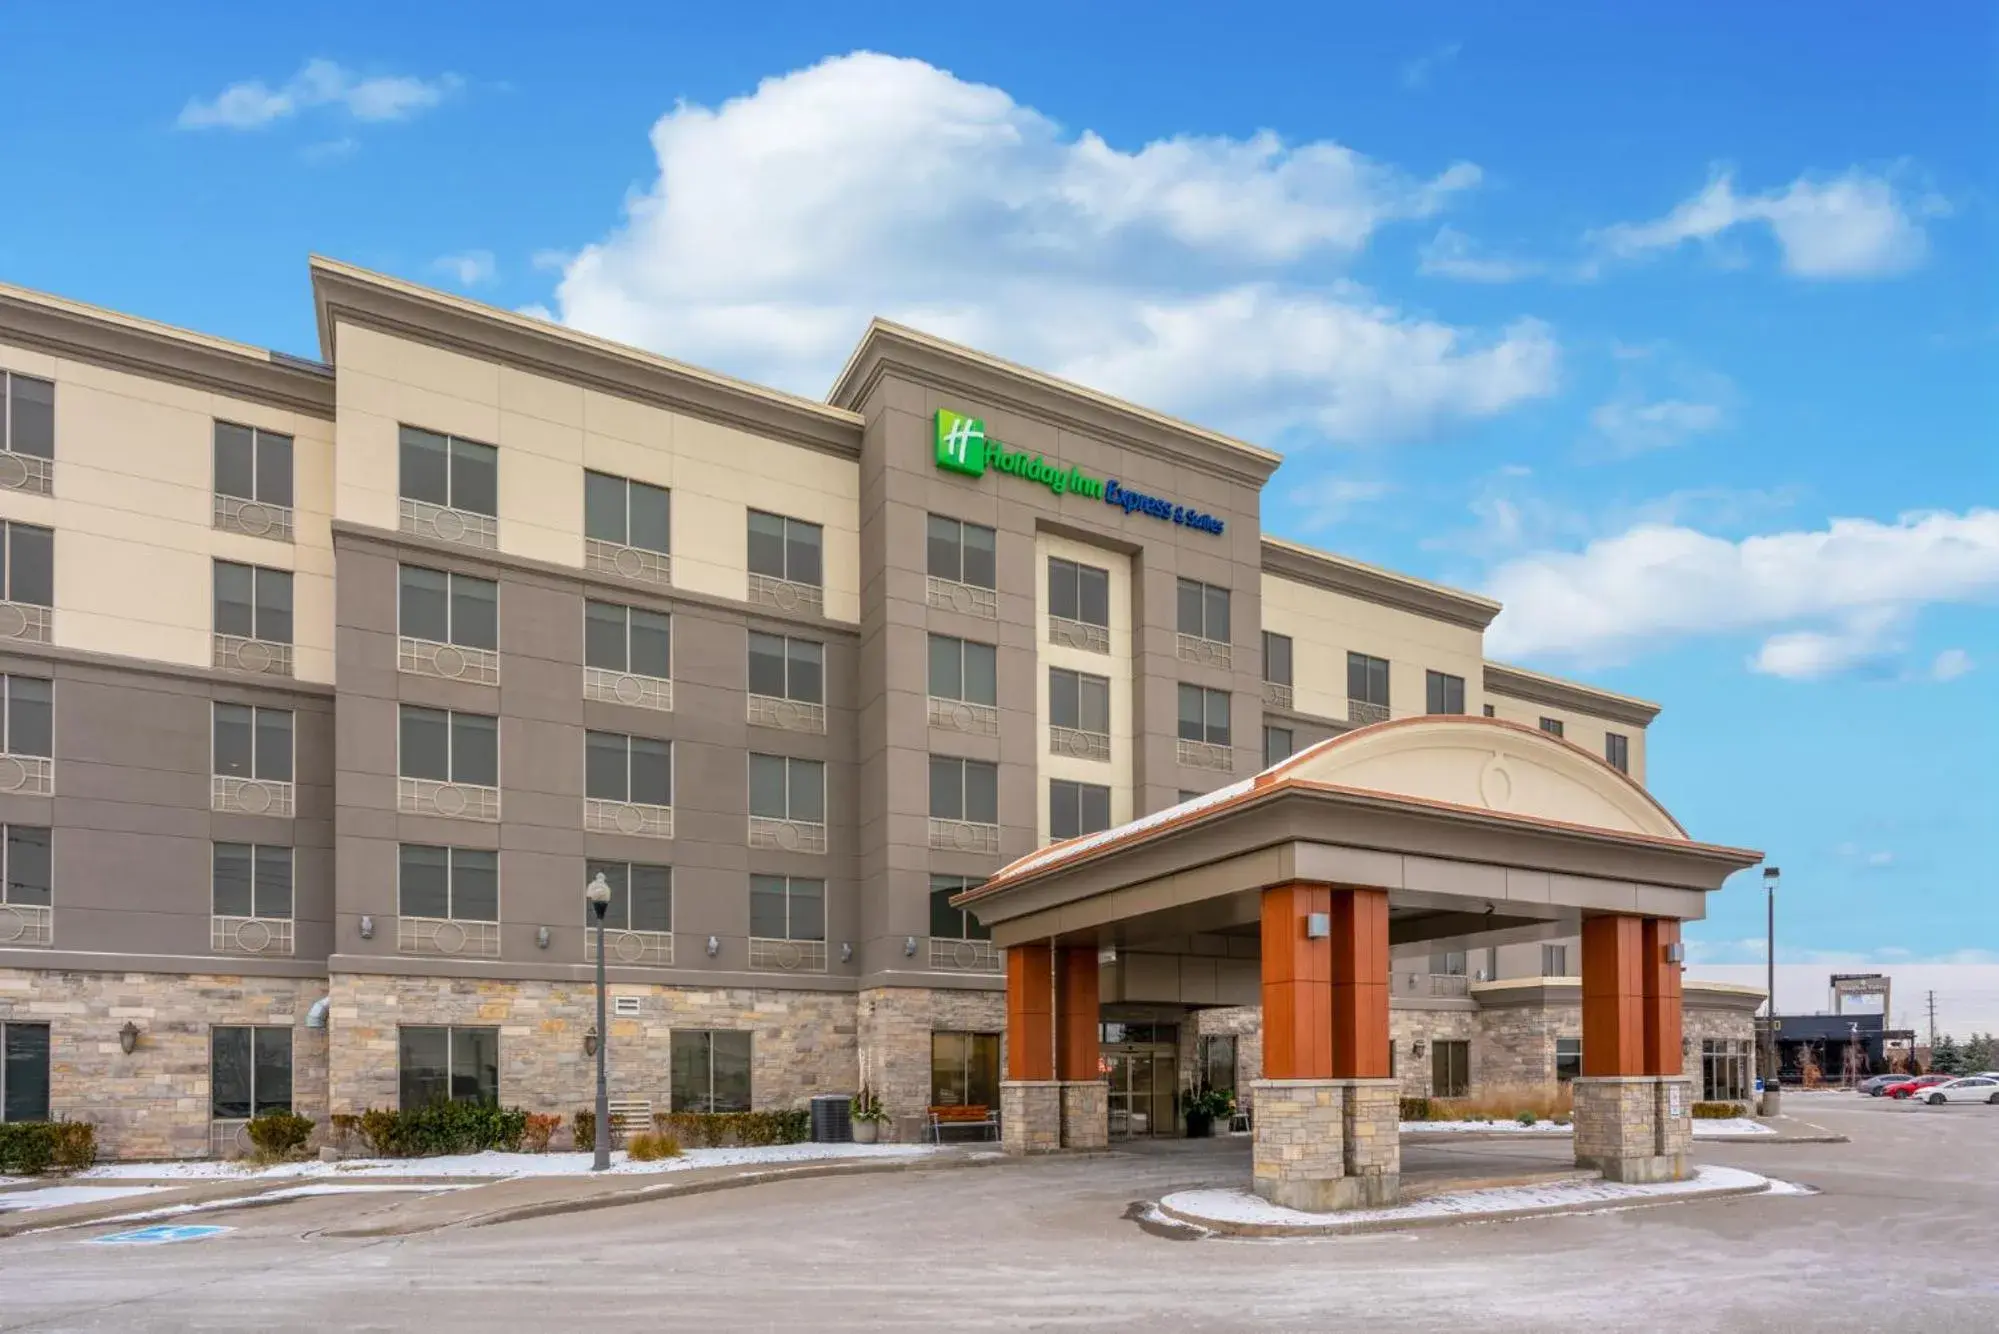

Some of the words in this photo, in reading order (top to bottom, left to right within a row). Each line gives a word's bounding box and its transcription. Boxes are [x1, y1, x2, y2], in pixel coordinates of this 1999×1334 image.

[944, 419, 984, 464] H
[984, 440, 1067, 496] Holiday
[1069, 466, 1103, 501] Inn
[1105, 480, 1172, 520] Express
[1173, 505, 1184, 524] &
[1185, 509, 1224, 535] Suites
